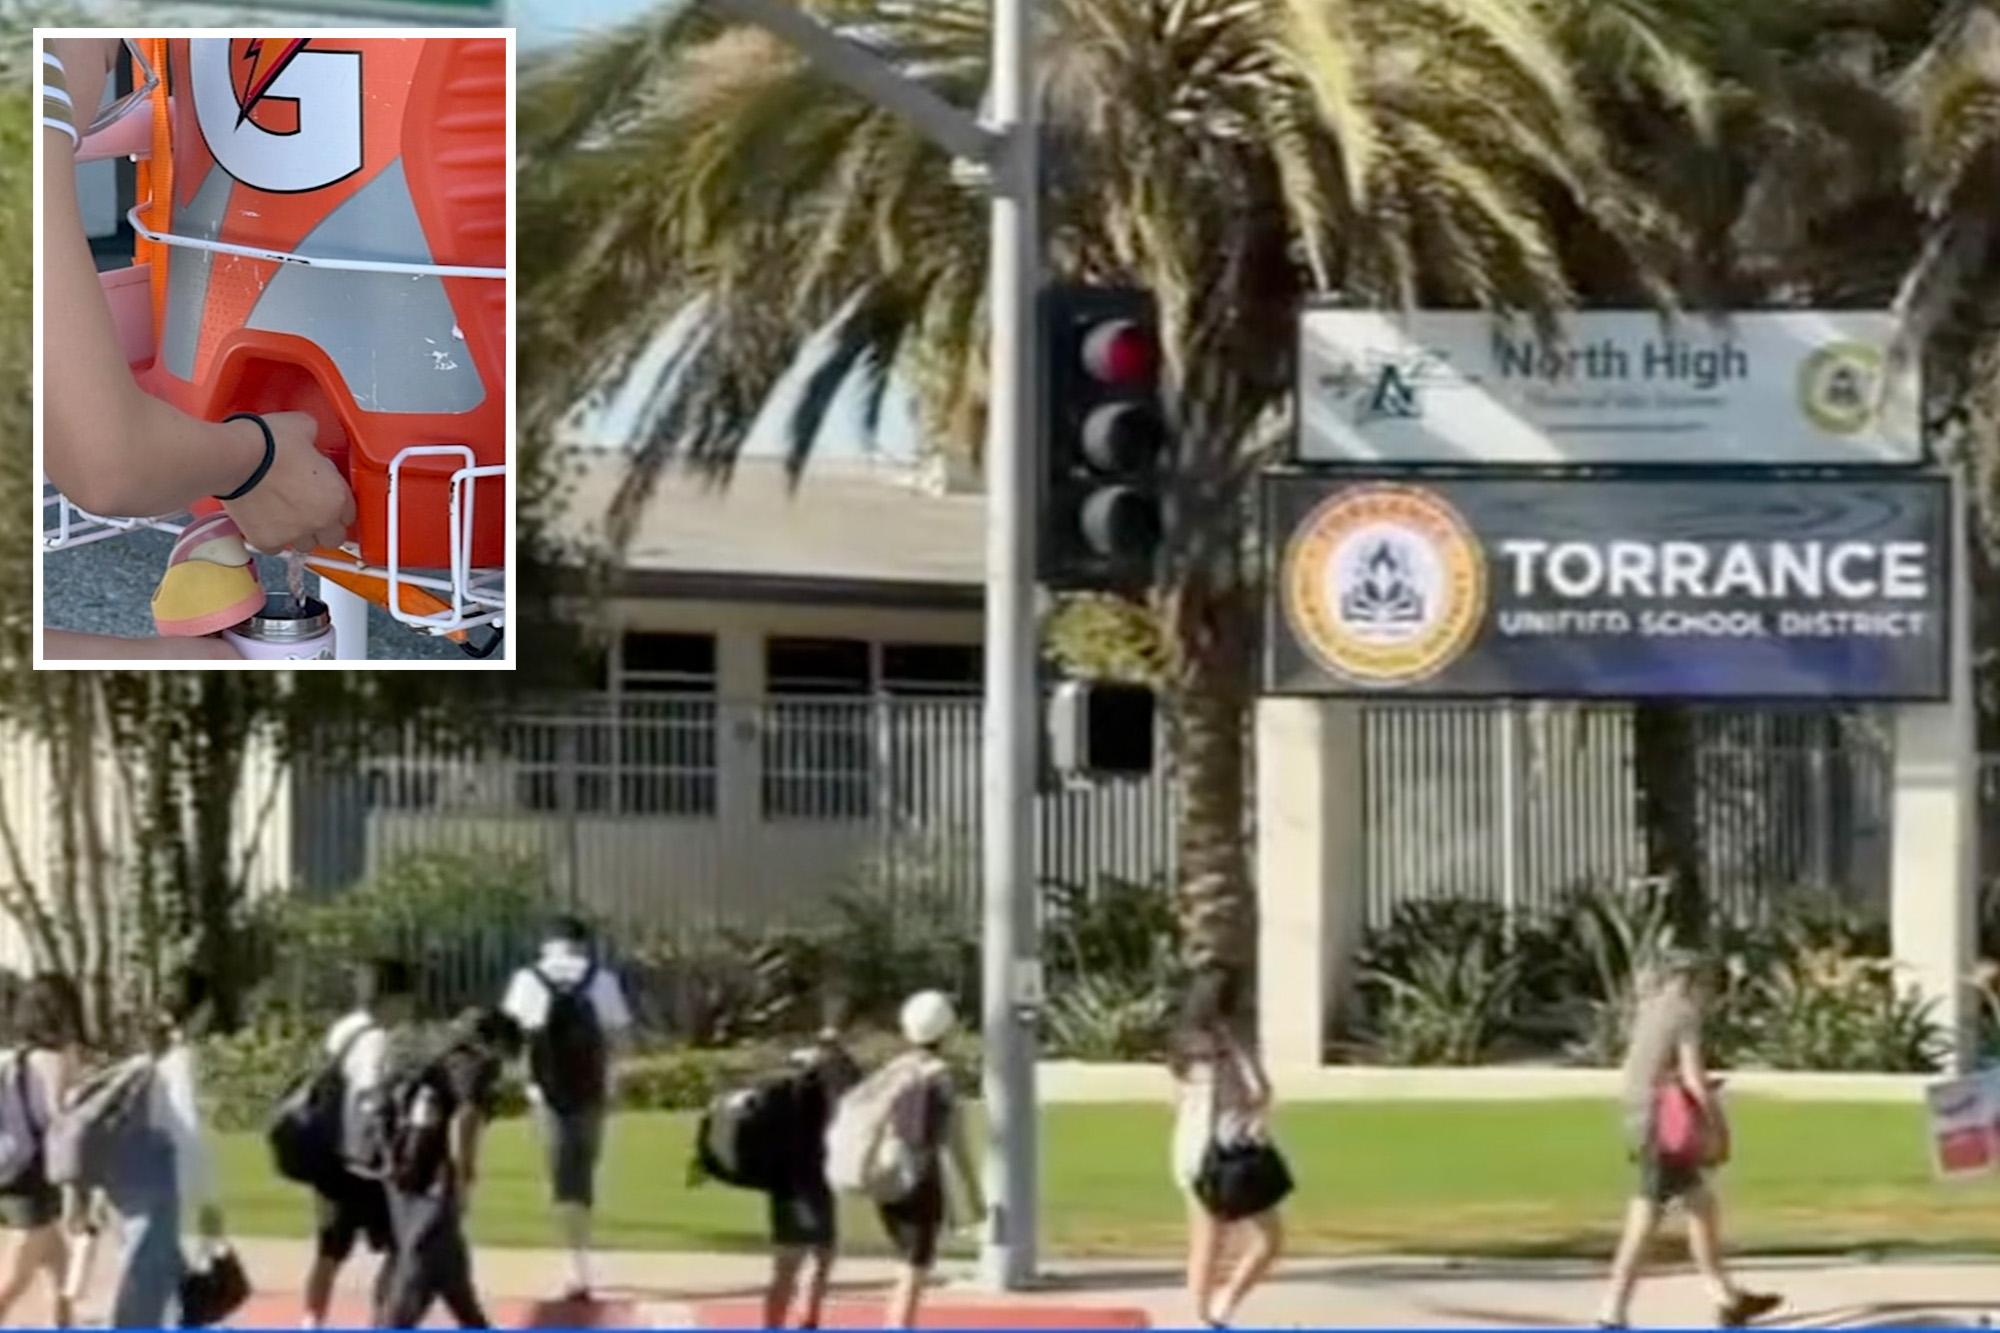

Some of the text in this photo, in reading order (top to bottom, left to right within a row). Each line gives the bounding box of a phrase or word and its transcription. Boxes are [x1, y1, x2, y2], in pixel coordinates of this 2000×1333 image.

[188, 38, 364, 194] G
[1501, 338, 1630, 378] North
[1641, 337, 1748, 390] High
[1502, 541, 1928, 598] TORRANCE
[1638, 610, 1769, 637] SCHOOL
[1779, 610, 1925, 637] DISTRICT
